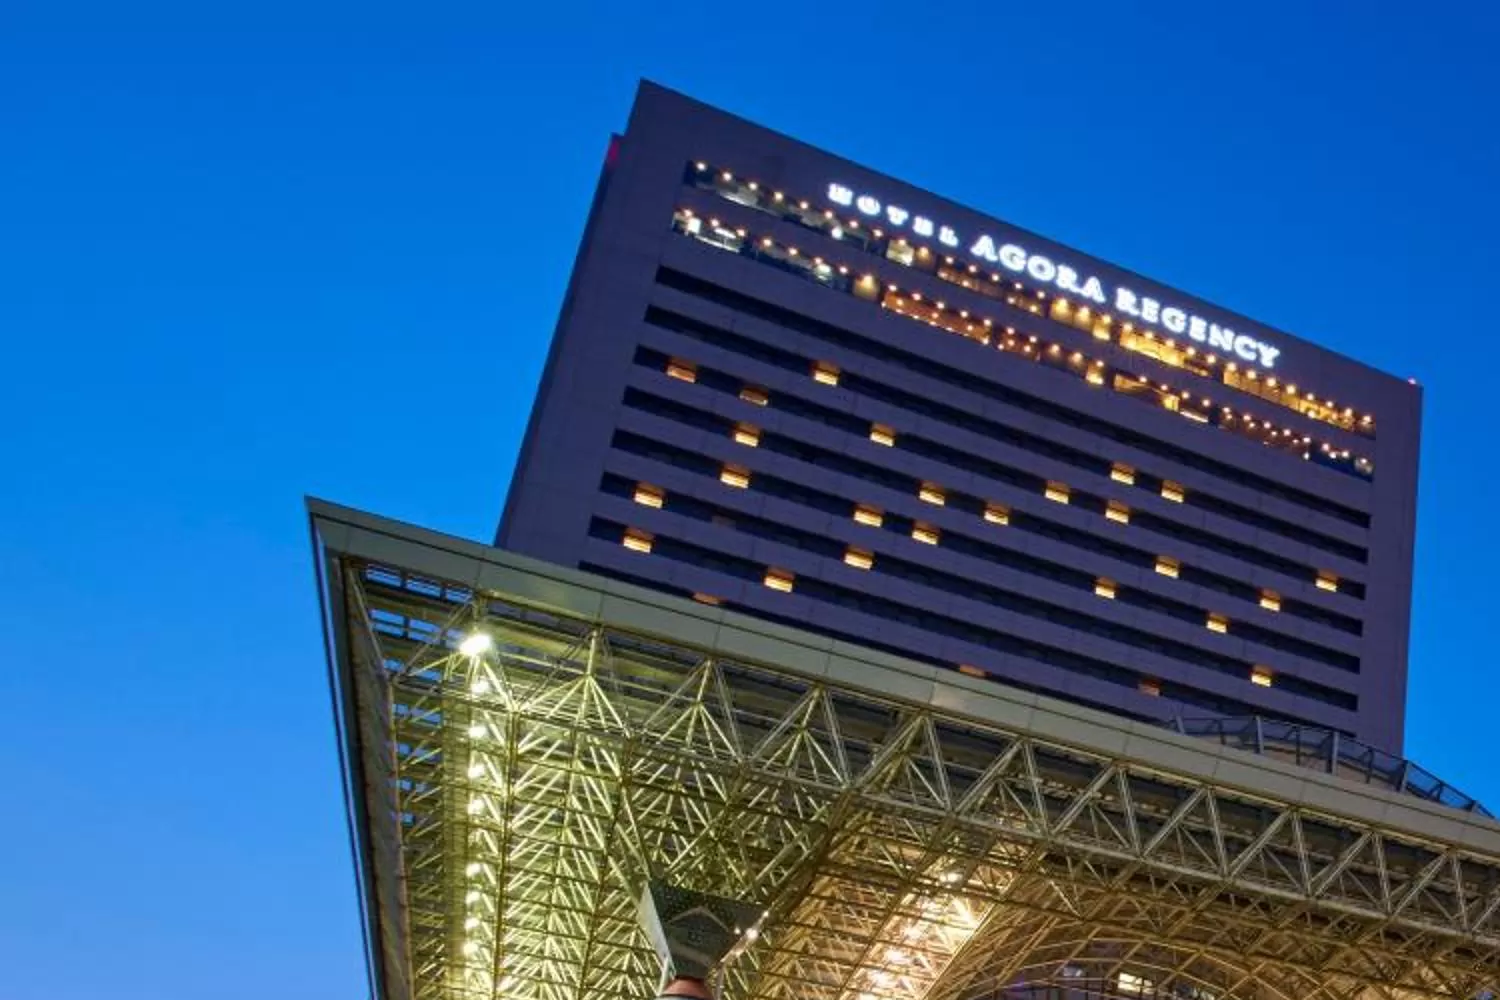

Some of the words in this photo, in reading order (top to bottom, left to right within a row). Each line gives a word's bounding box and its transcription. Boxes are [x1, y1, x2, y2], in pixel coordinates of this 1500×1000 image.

[827, 182, 960, 248] HOTEL
[971, 234, 1106, 303] AGORA
[1116, 287, 1281, 369] REGENCY
